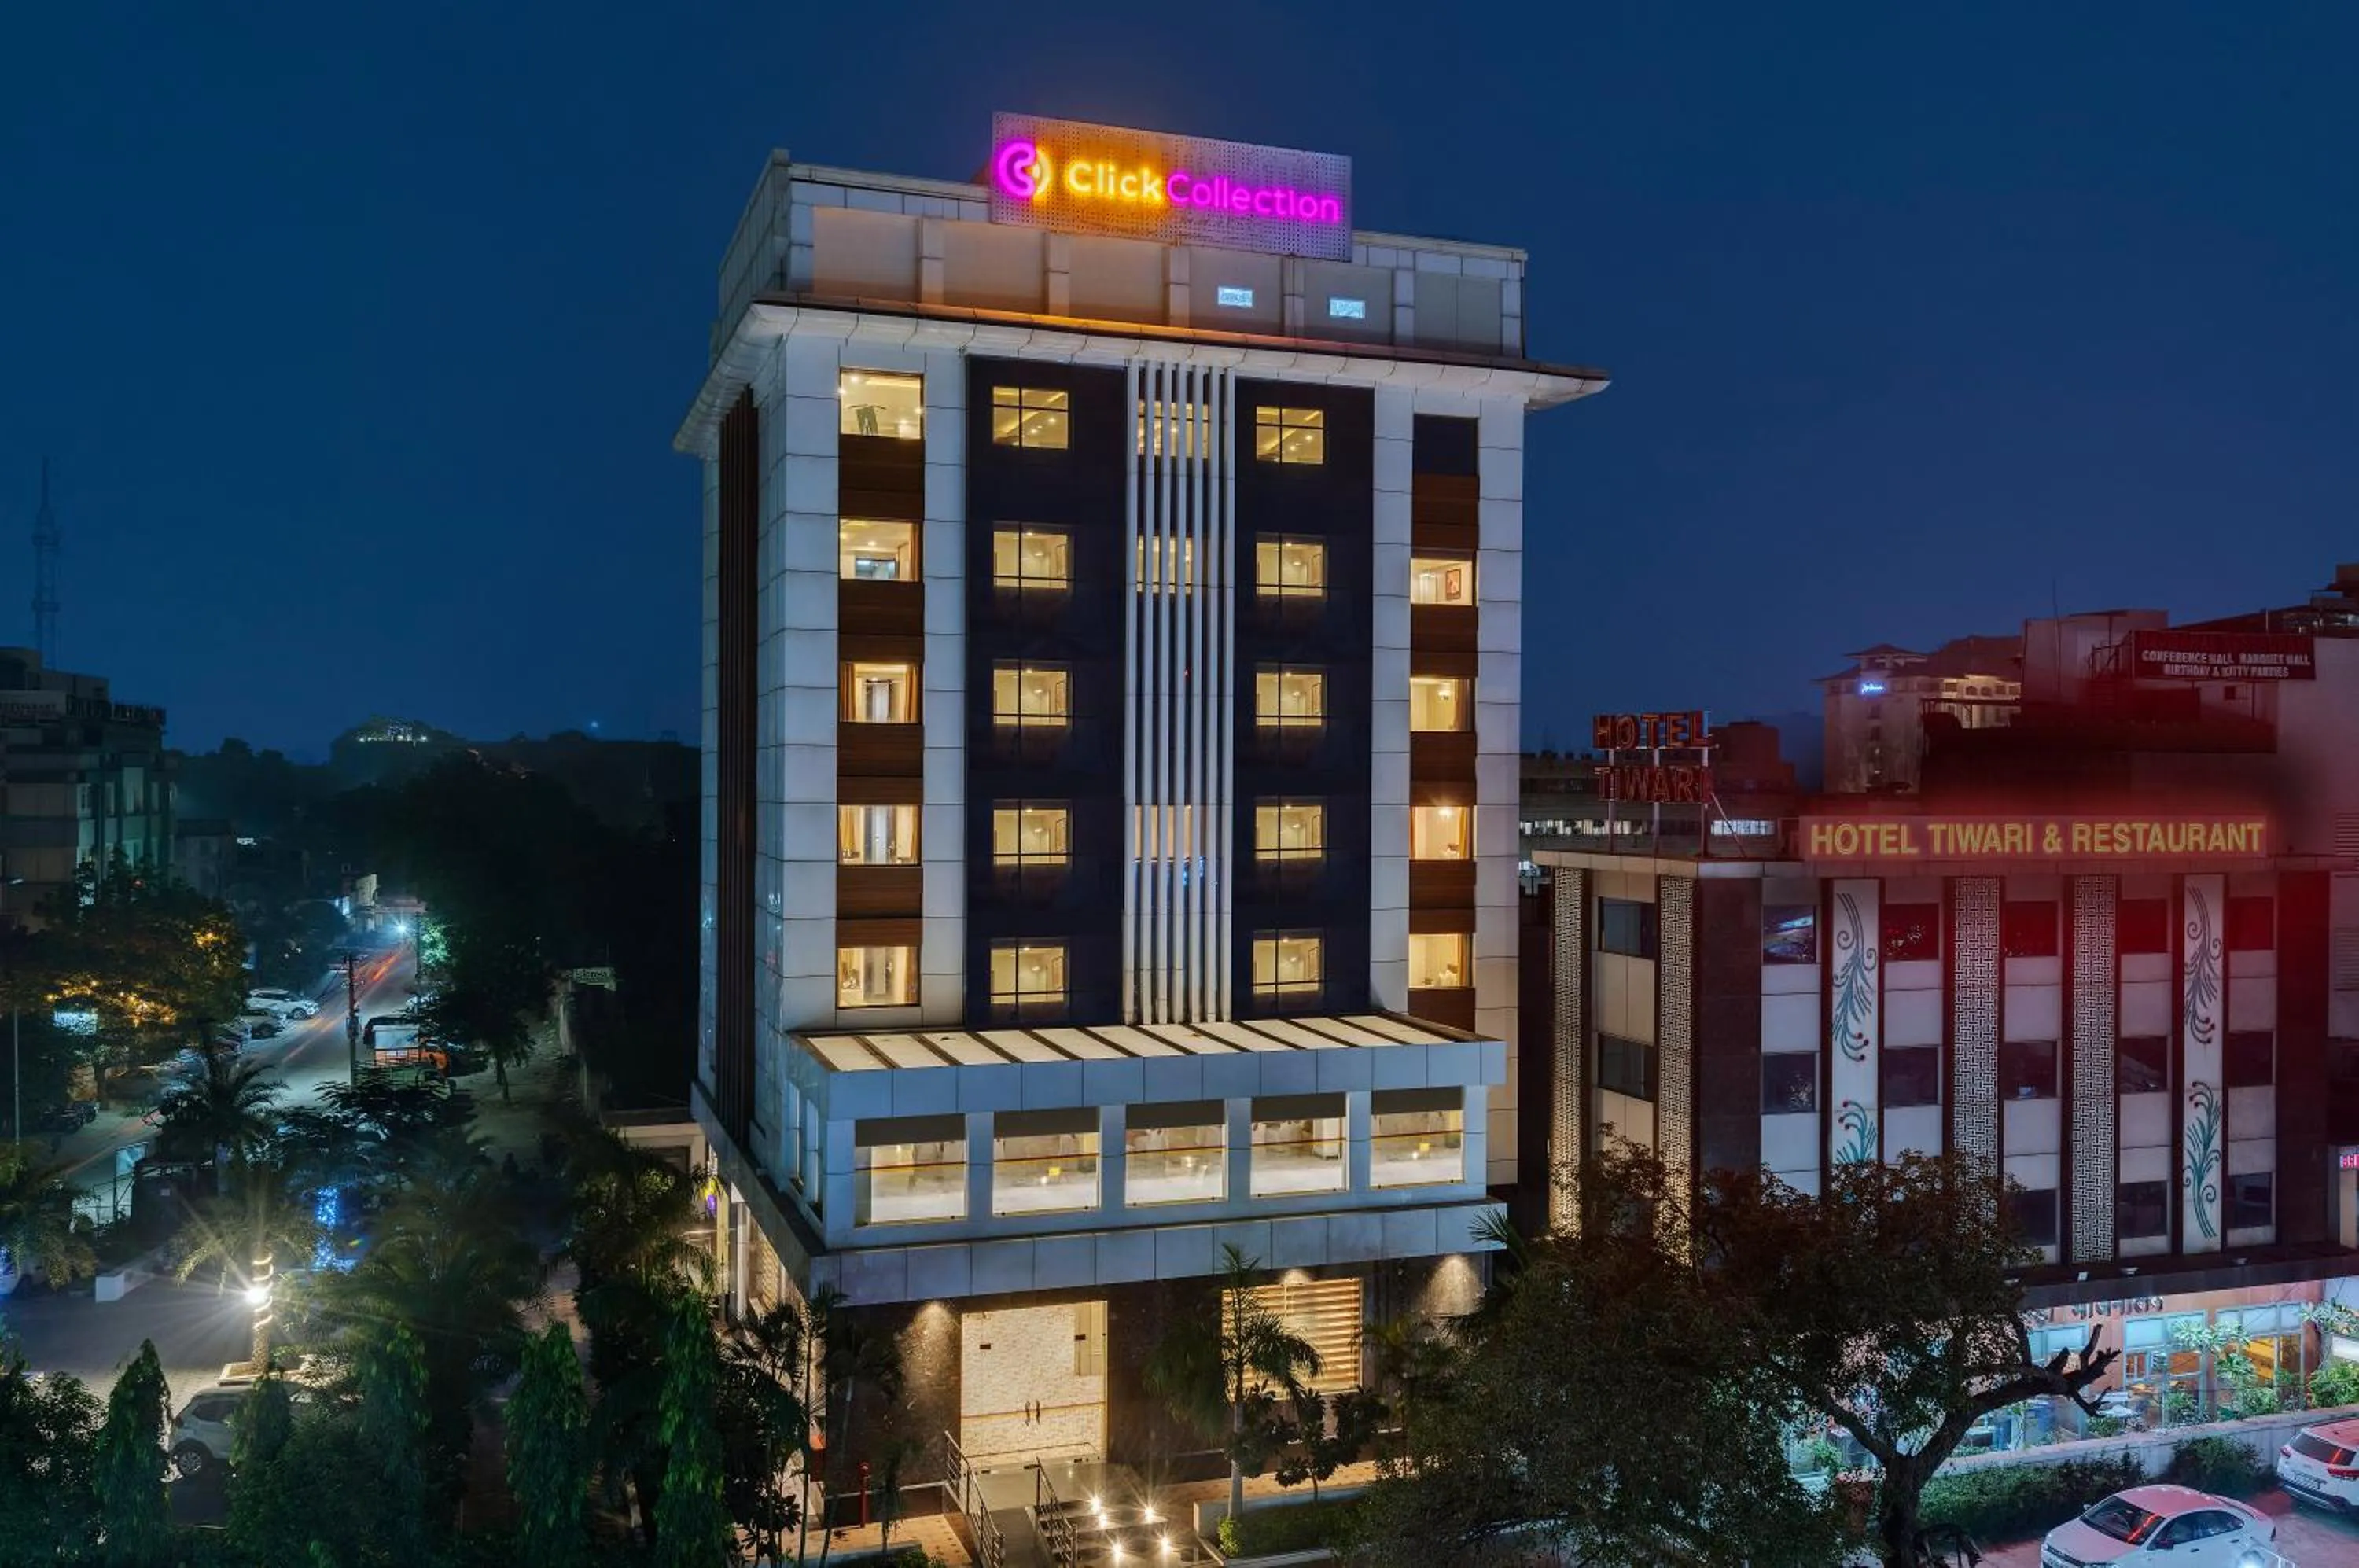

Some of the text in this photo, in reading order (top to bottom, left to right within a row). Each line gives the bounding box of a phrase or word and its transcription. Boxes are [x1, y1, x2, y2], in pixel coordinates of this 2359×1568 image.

[2142, 650, 2207, 663] CONFERENCE
[2164, 664, 2210, 676] BIRTHDAY
[2250, 666, 2289, 678] PARTIES
[1594, 712, 1709, 748] HOTEL
[1595, 766, 1713, 804] TIWARI
[1810, 822, 2264, 855] HOTEL TIWARI & RESTAURANT
